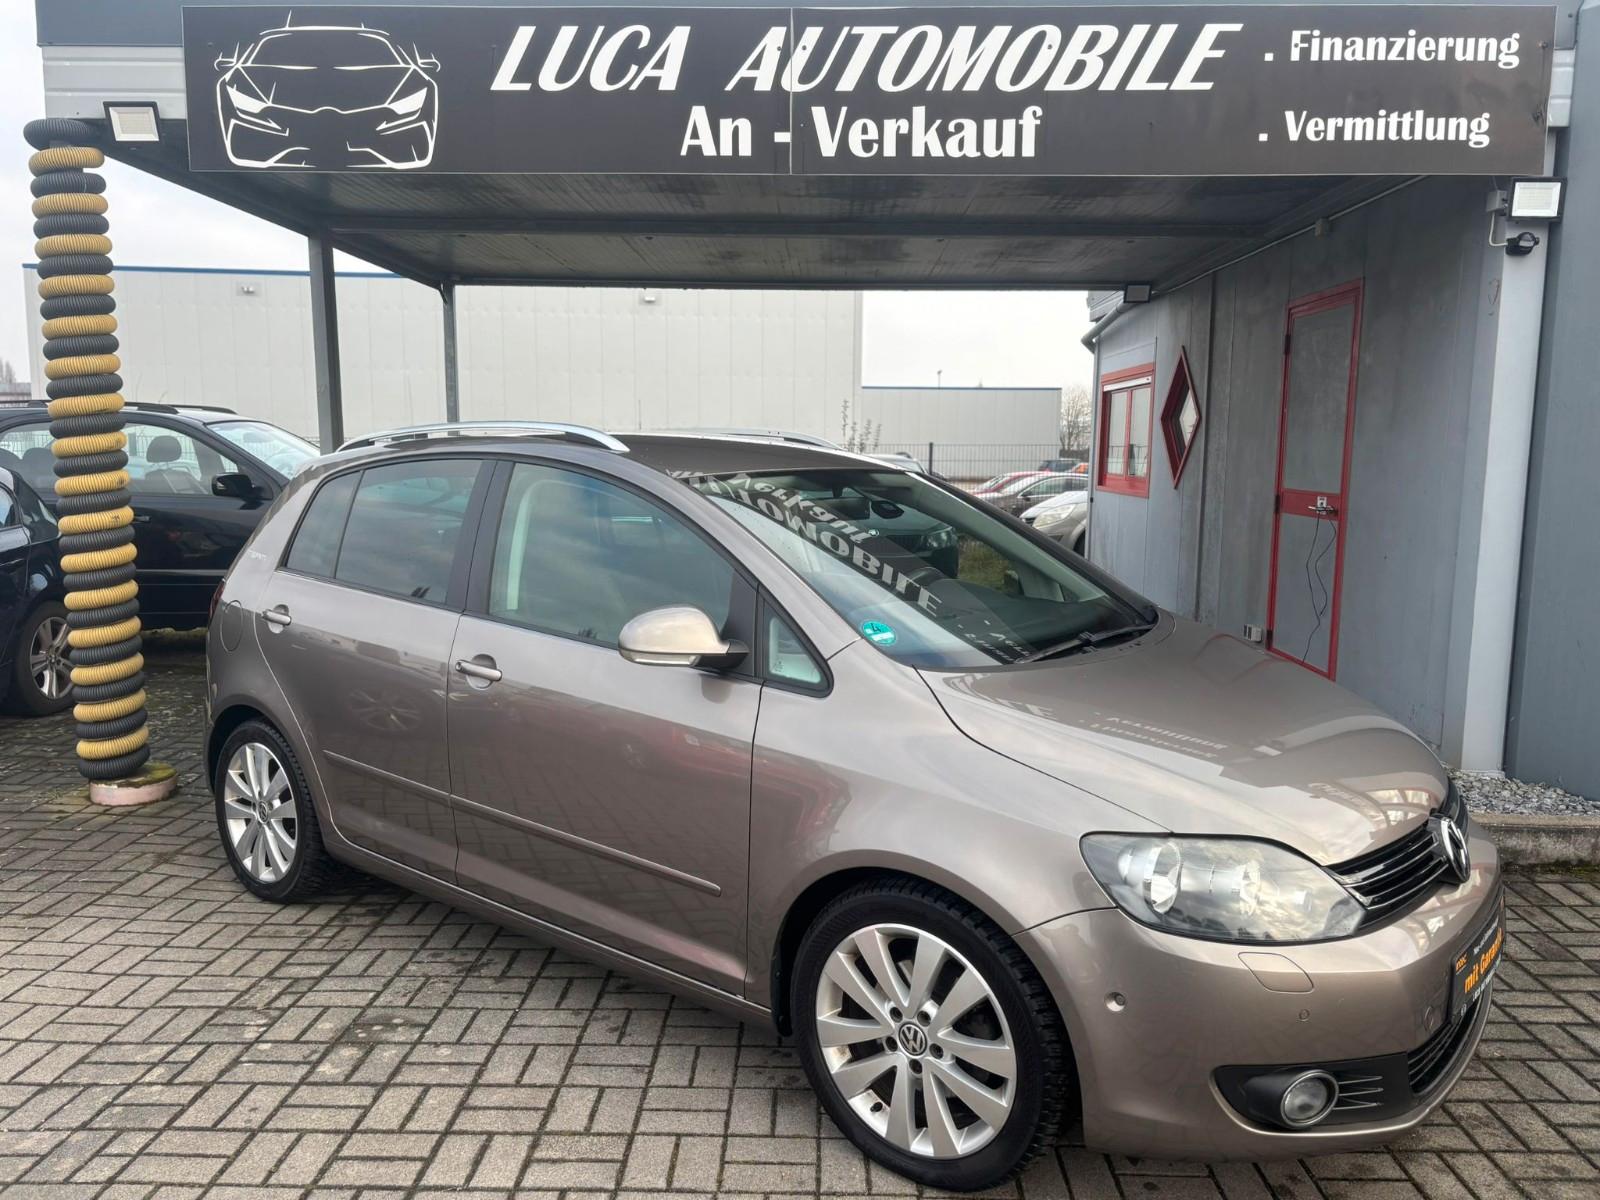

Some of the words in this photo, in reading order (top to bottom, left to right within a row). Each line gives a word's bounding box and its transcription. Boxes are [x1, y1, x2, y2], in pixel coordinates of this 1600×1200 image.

[490, 25, 691, 91] LUCA
[724, 24, 1244, 92] AUTOMOBILE
[1290, 29, 1520, 69] Finanzierung
[680, 106, 752, 157] An
[811, 106, 1042, 158] Verkauf
[1285, 109, 1491, 149] Vermittlung
